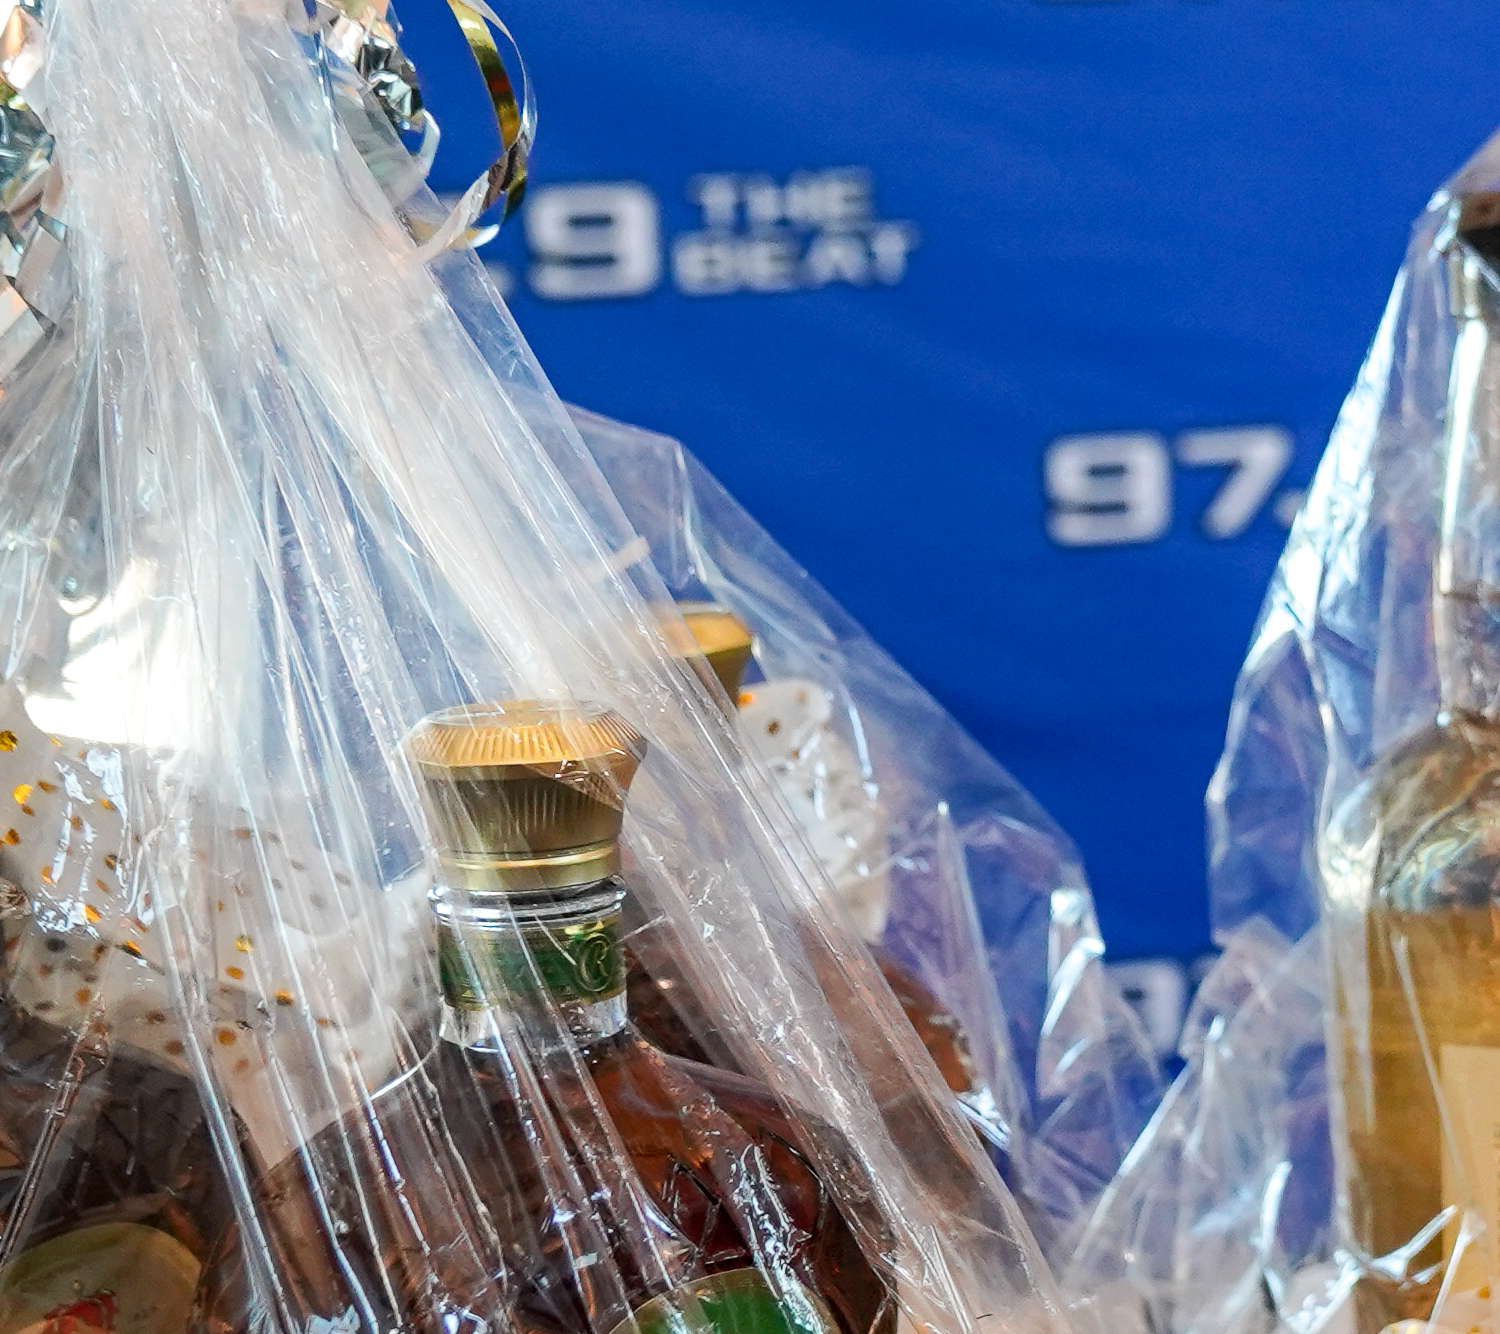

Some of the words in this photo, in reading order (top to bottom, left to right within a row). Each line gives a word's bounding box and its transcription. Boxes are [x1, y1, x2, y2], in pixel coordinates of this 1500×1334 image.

[692, 169, 878, 233] THE
[672, 223, 918, 297] BEAT
[1045, 424, 1305, 547] 97.
